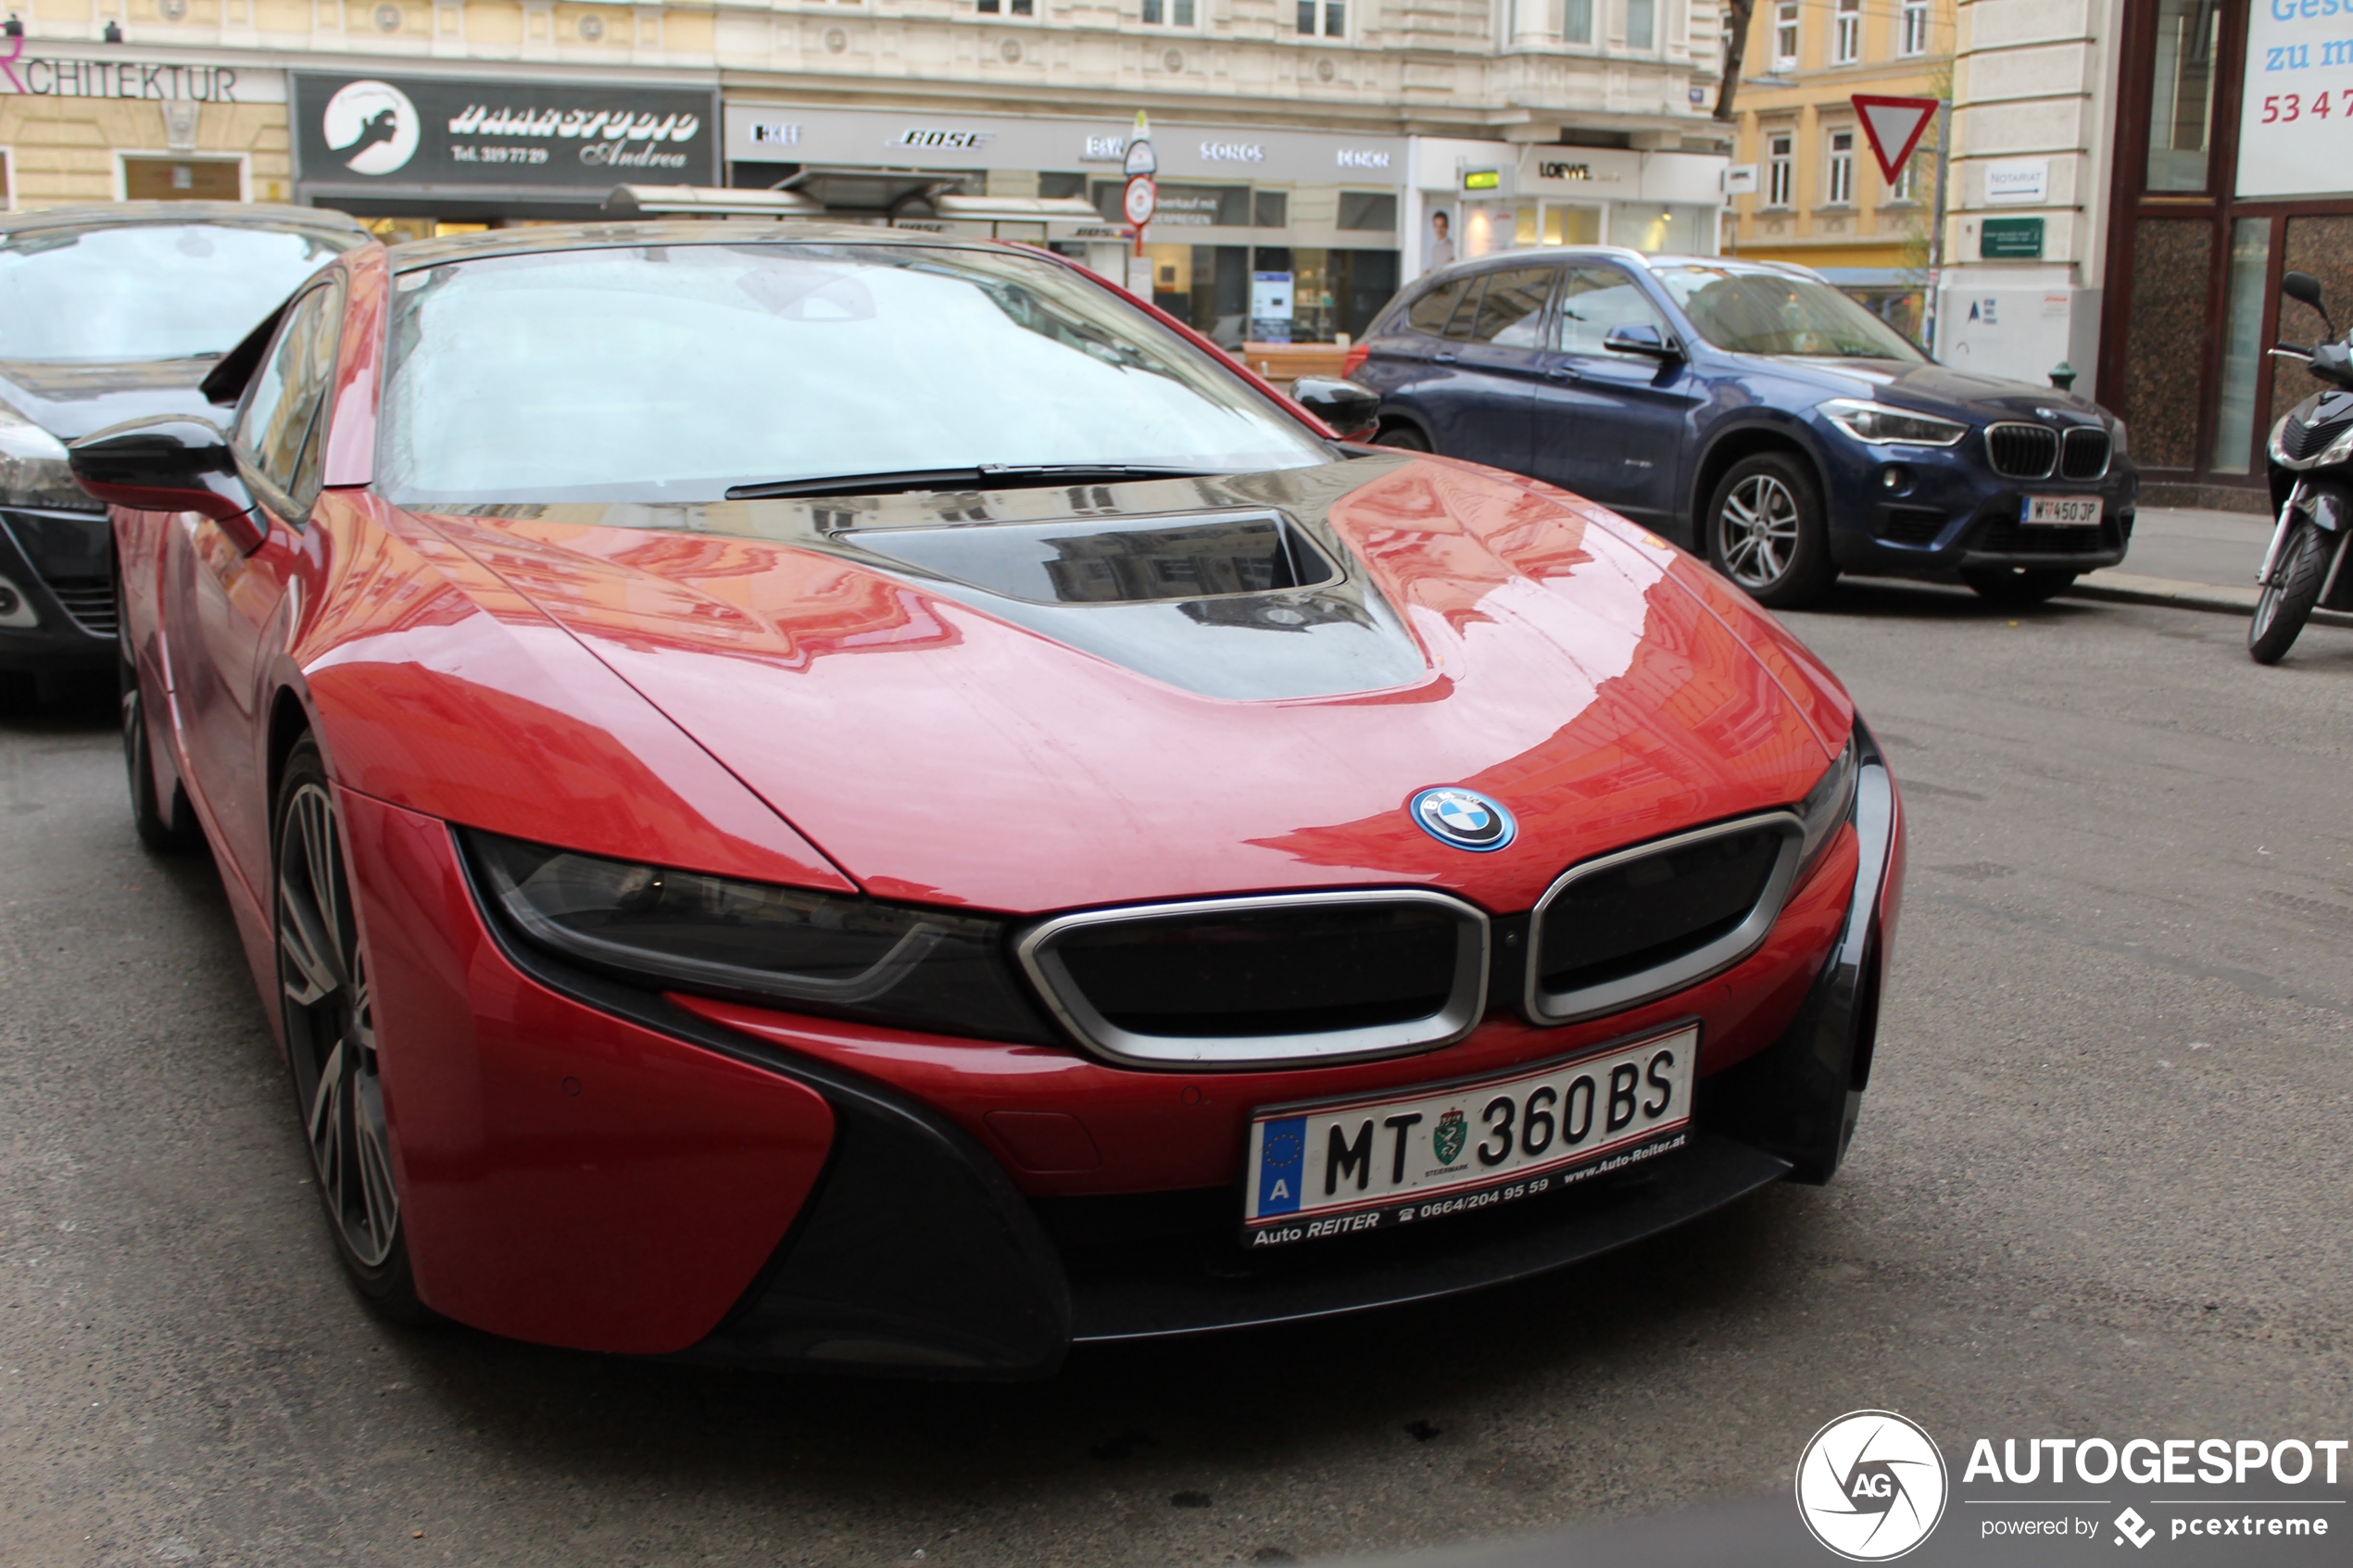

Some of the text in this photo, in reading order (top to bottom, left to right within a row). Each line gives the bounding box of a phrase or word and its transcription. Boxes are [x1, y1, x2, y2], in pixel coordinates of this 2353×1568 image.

[2271, 0, 2353, 22] Ges
[2265, 43, 2309, 71] zu
[2261, 93, 2300, 124] 53
[891, 129, 991, 150] BOSE
[579, 139, 689, 169] Andrea
[1424, 791, 1481, 810] BMW
[1325, 1112, 1423, 1196] MT
[1424, 1163, 1469, 1178] STEIERMARK
[1253, 1228, 1302, 1247] Auto
[1306, 1212, 1380, 1239] REITER
[1504, 1184, 1525, 1201] 95
[1529, 1178, 1550, 1193] 59
[1563, 1133, 1686, 1185] www.Auto-Reiter.at
[1269, 1178, 1290, 1202] A
